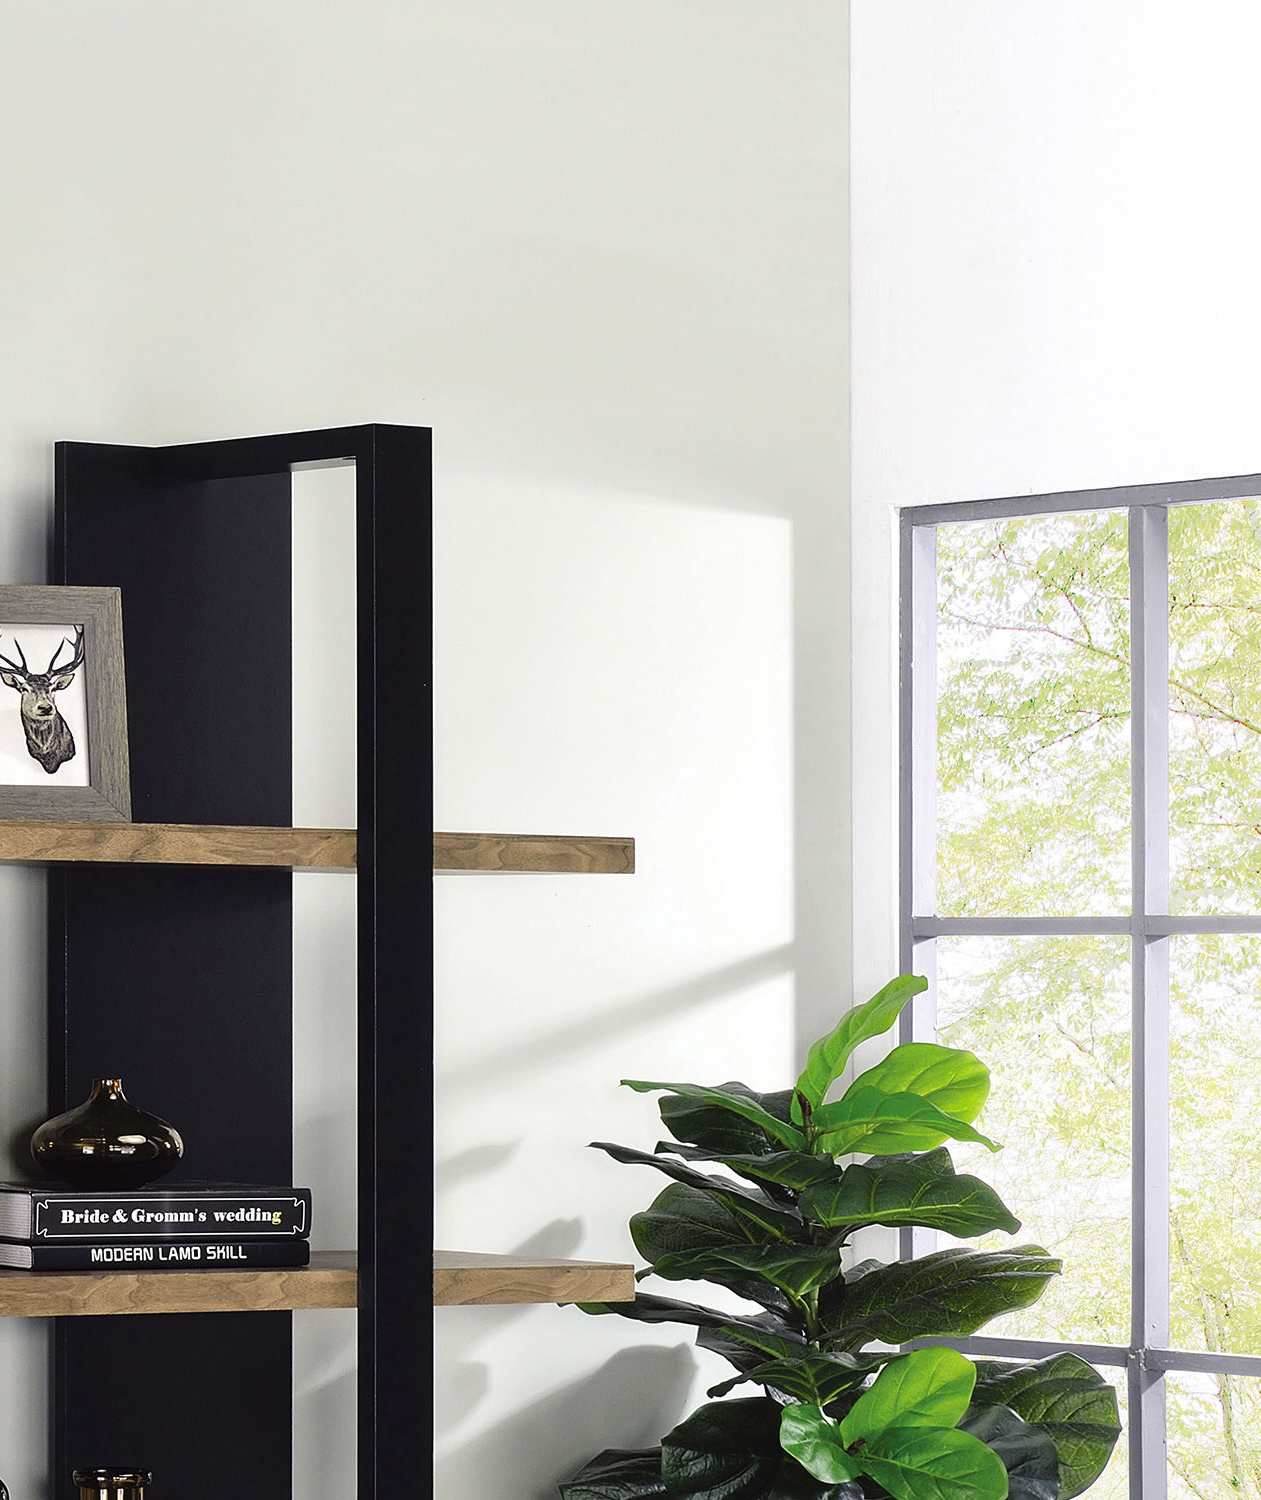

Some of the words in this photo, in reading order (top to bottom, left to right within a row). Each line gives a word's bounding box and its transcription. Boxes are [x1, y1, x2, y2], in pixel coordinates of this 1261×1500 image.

[60, 1209, 110, 1224] Bride
[112, 1208, 128, 1223] &
[131, 1208, 207, 1223] Gromm's
[213, 1207, 282, 1225] wedding
[91, 1247, 154, 1262] MODERN
[206, 1245, 248, 1260] SKILL
